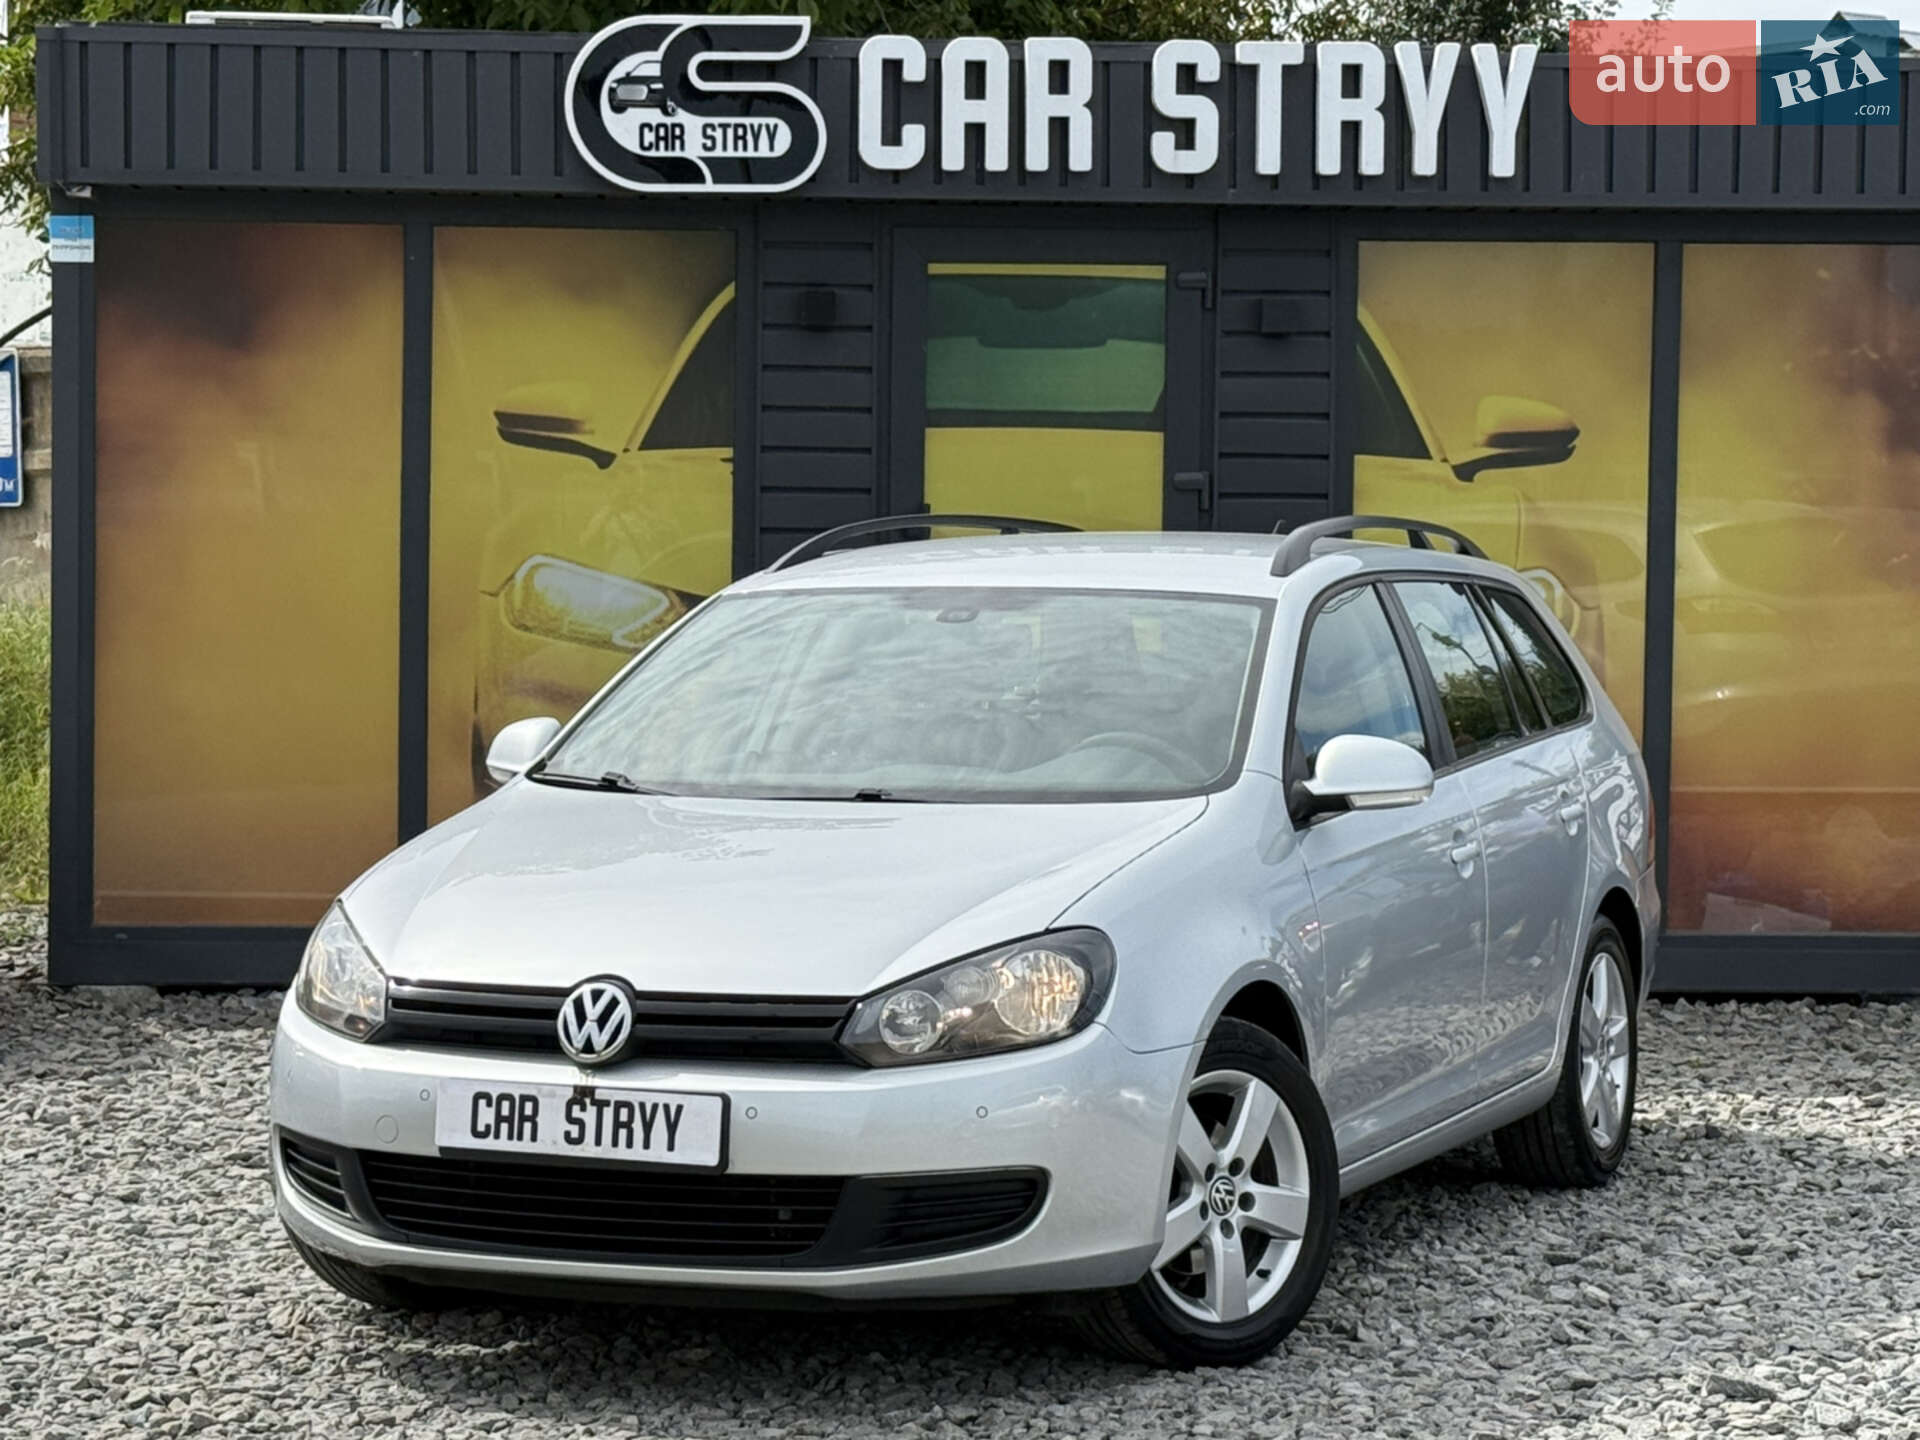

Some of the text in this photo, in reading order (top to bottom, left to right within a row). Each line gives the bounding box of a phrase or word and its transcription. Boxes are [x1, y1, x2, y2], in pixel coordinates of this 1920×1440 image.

[858, 34, 1539, 178] CAR STRYY
[638, 122, 779, 153] CAR STRYY
[470, 1091, 684, 1152] CAR STRYY
